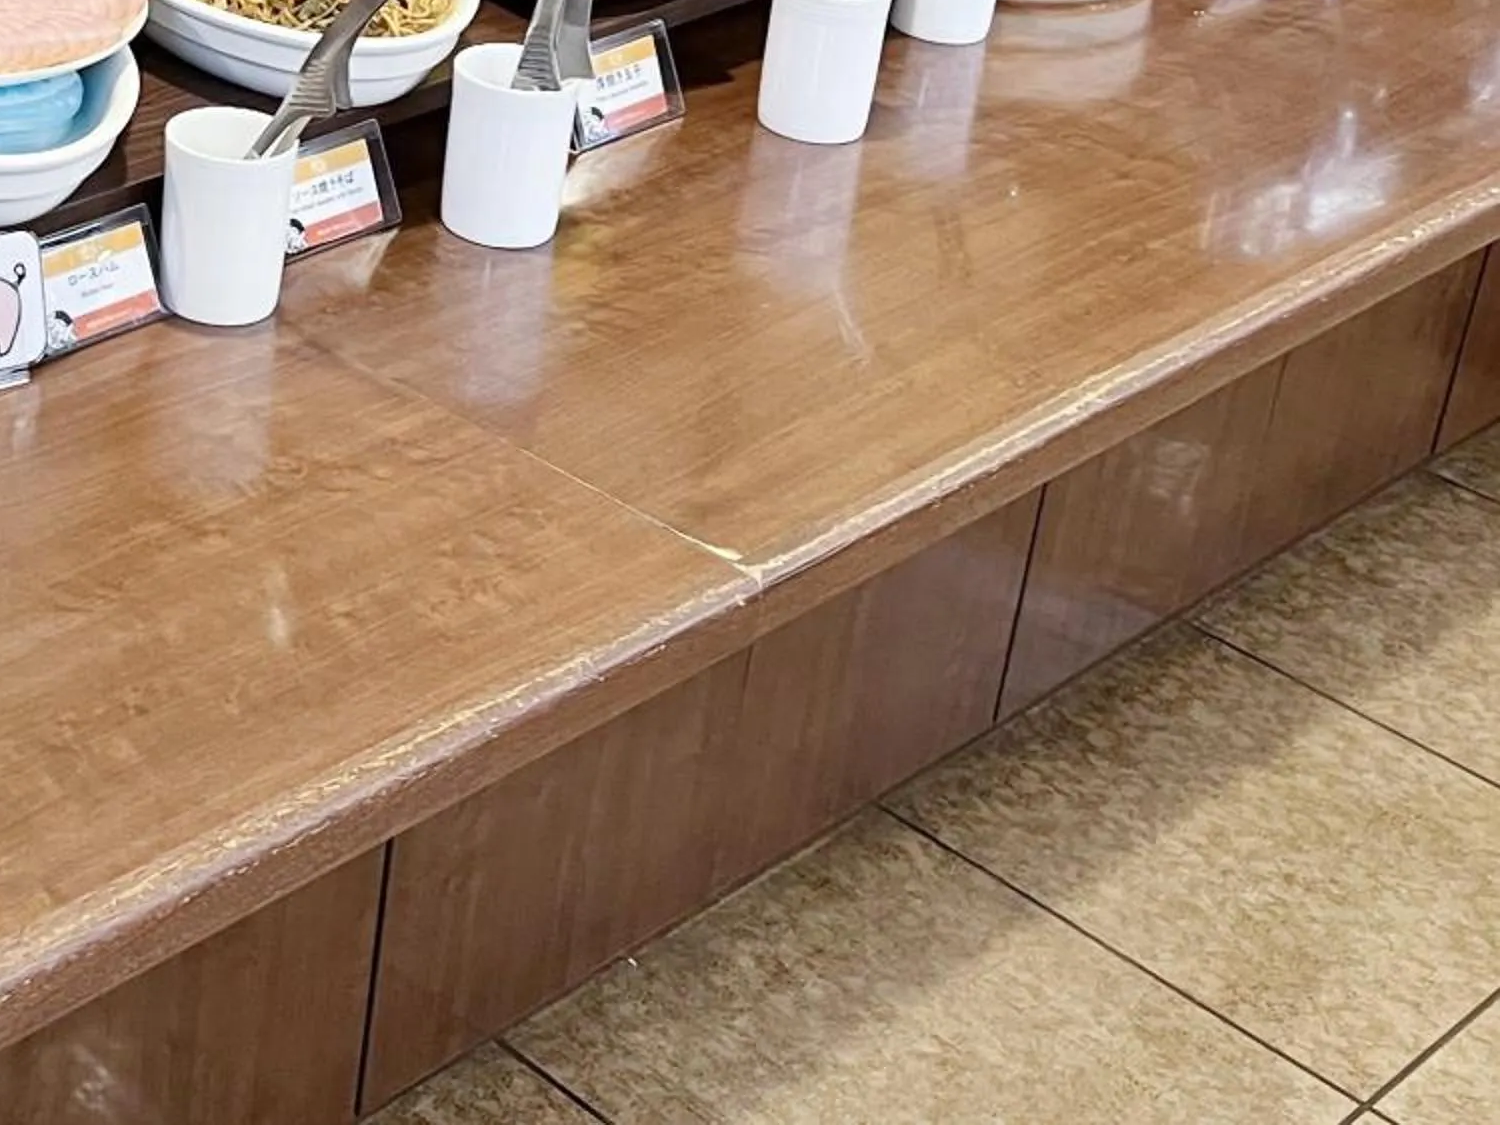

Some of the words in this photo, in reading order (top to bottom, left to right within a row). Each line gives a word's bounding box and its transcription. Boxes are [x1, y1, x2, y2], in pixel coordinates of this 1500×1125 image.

[67, 261, 120, 287] ロースハム
